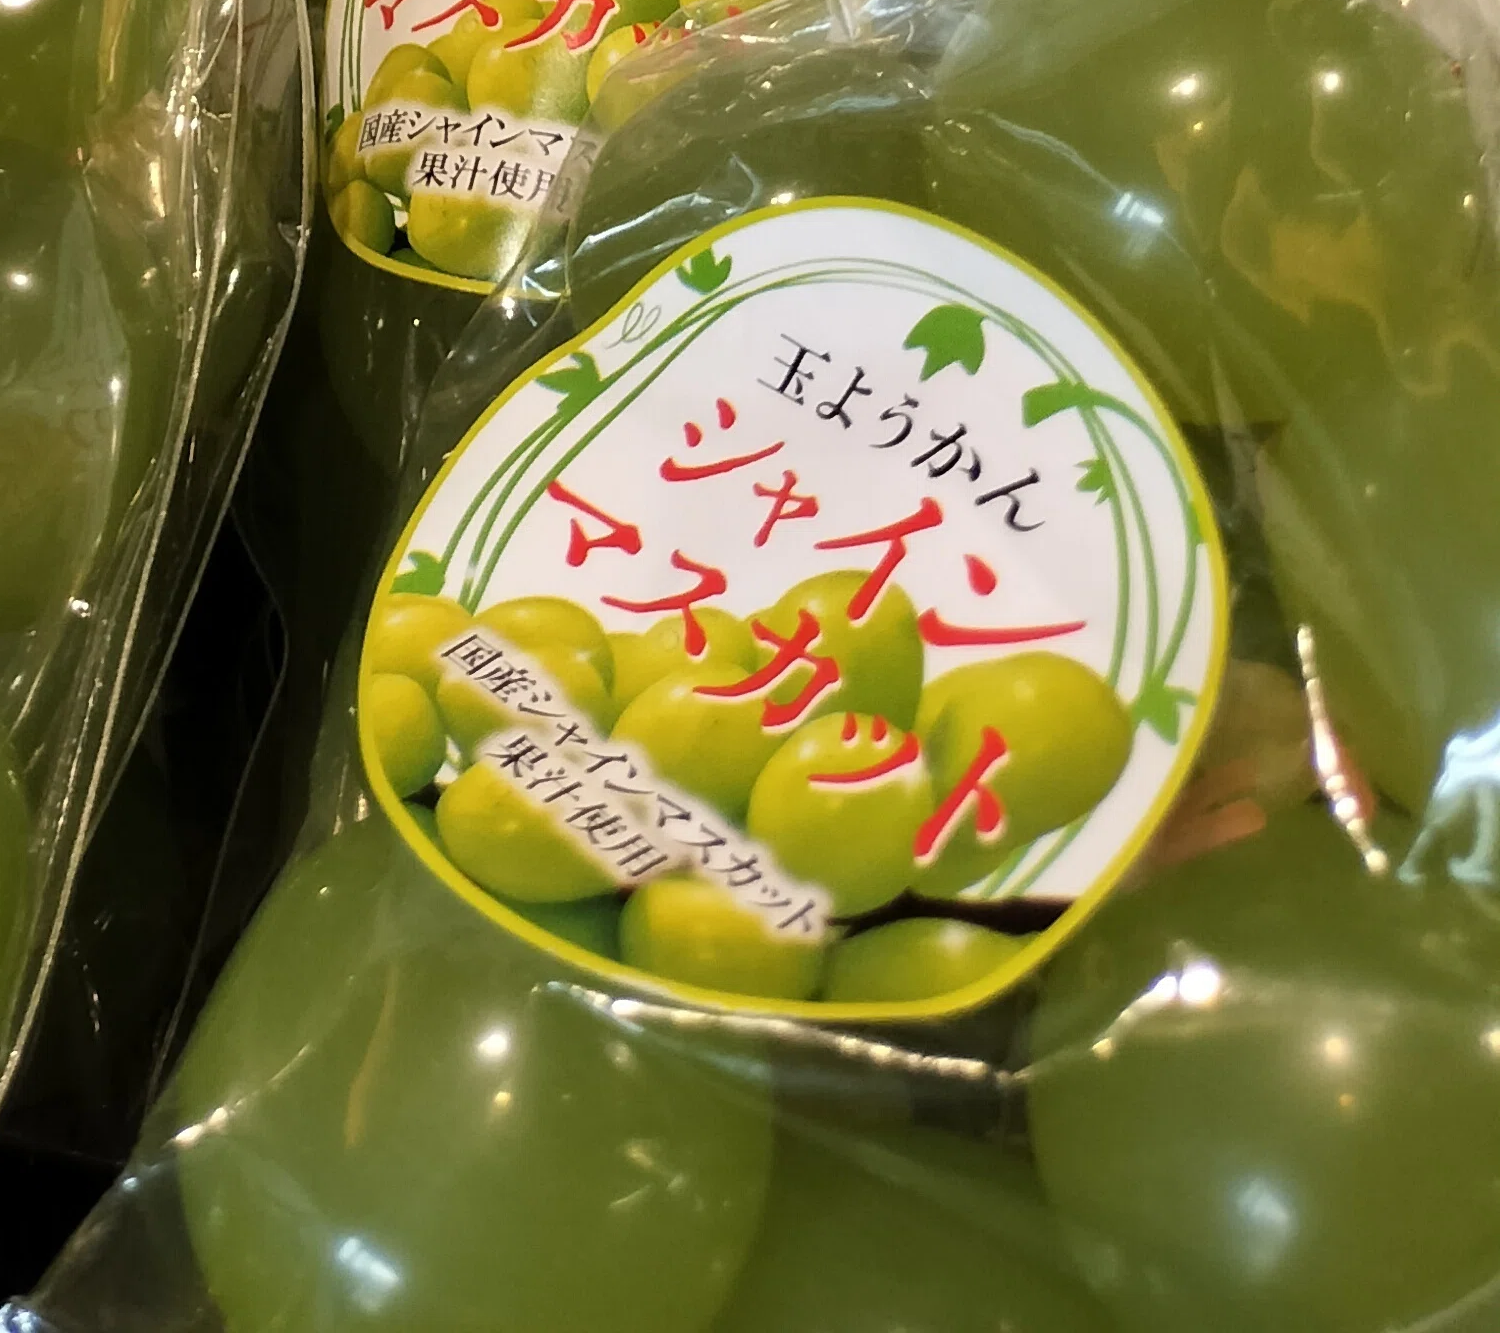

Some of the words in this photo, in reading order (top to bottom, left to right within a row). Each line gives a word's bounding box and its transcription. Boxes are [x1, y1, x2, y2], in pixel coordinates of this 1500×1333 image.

[660, 397, 1088, 647] シャイン
[756, 333, 1046, 532] 玉ようかん
[440, 634, 816, 933] 国産シャインマスカット
[547, 480, 1007, 860] マスカット
[486, 734, 668, 877] 果汁使用
